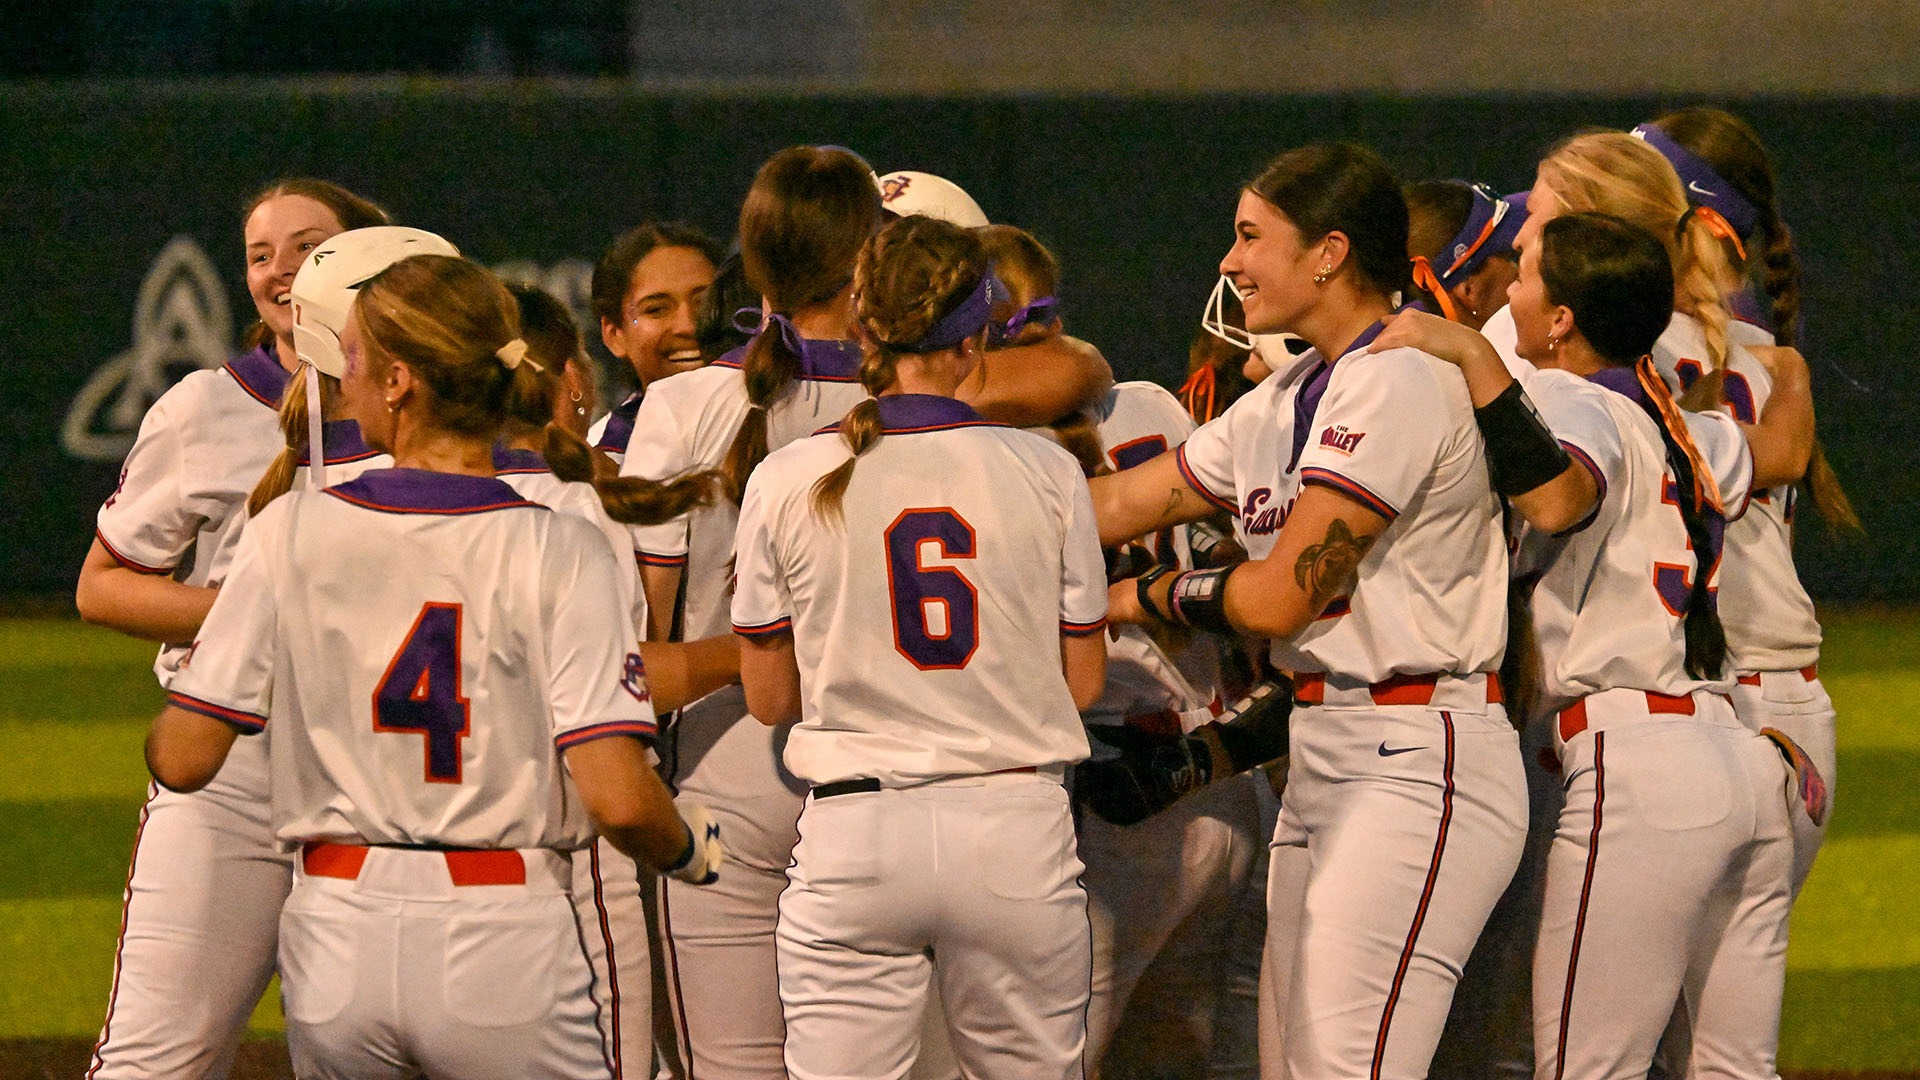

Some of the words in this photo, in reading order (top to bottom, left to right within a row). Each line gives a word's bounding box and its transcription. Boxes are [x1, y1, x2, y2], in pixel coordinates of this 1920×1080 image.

[1319, 425, 1367, 454] VALLEY
[1336, 424, 1349, 433] THE
[883, 506, 979, 671] 6
[371, 601, 470, 784] 4
